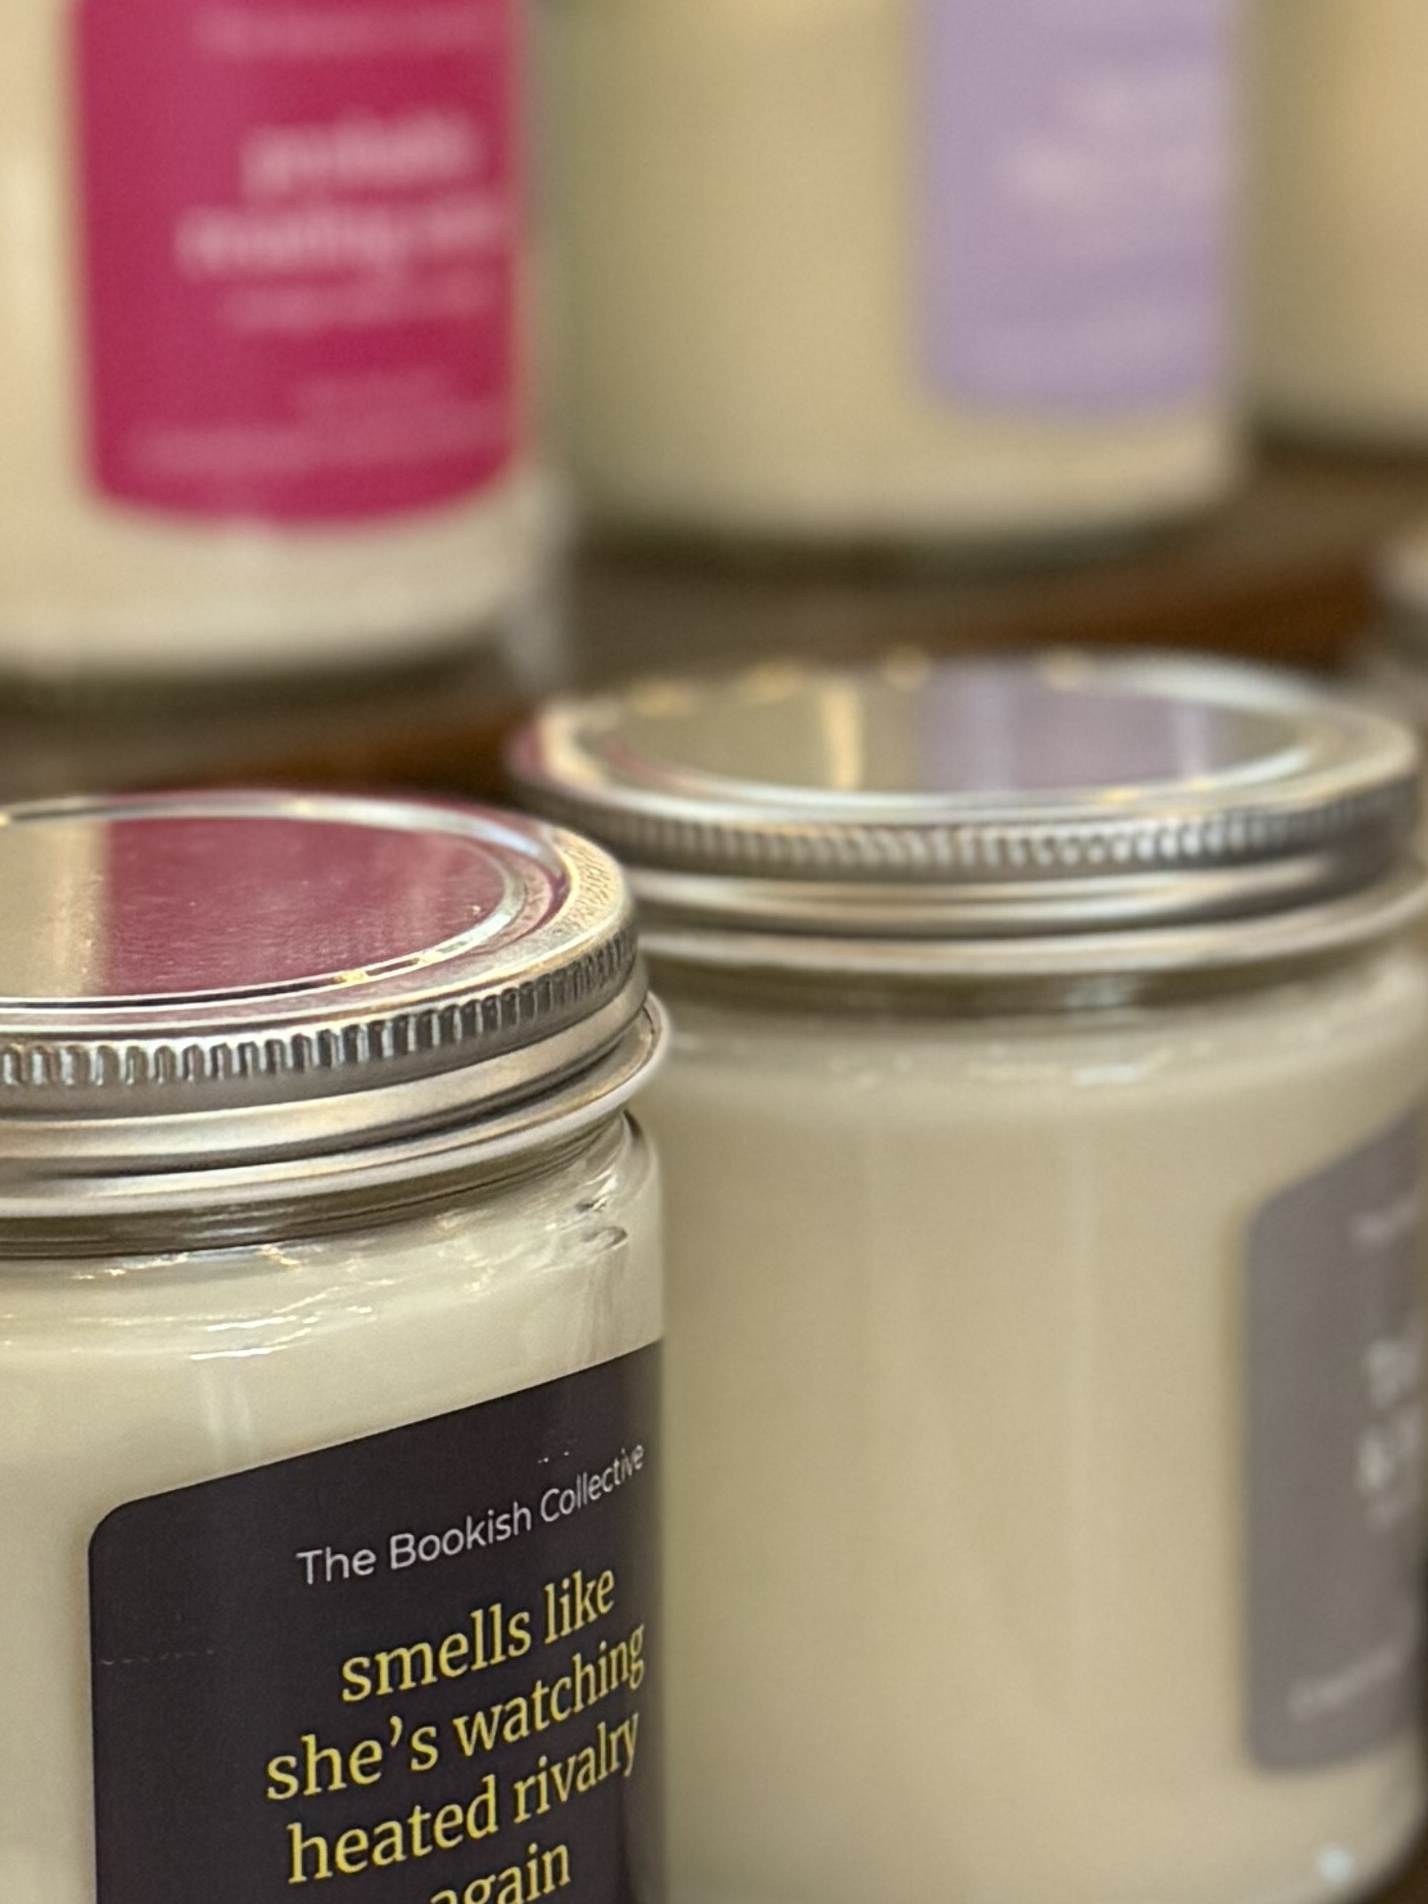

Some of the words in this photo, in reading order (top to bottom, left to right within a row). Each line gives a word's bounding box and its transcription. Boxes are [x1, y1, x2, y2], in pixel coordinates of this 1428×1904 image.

[295, 1546, 377, 1585] The
[390, 1501, 532, 1571] Bookish
[539, 1444, 645, 1524] Collective
[266, 1715, 440, 1801] she's
[453, 1623, 645, 1757] watching
[341, 1602, 532, 1702] smells
[542, 1569, 616, 1645] like
[286, 1774, 500, 1884] heated
[513, 1712, 640, 1825] rivalry
